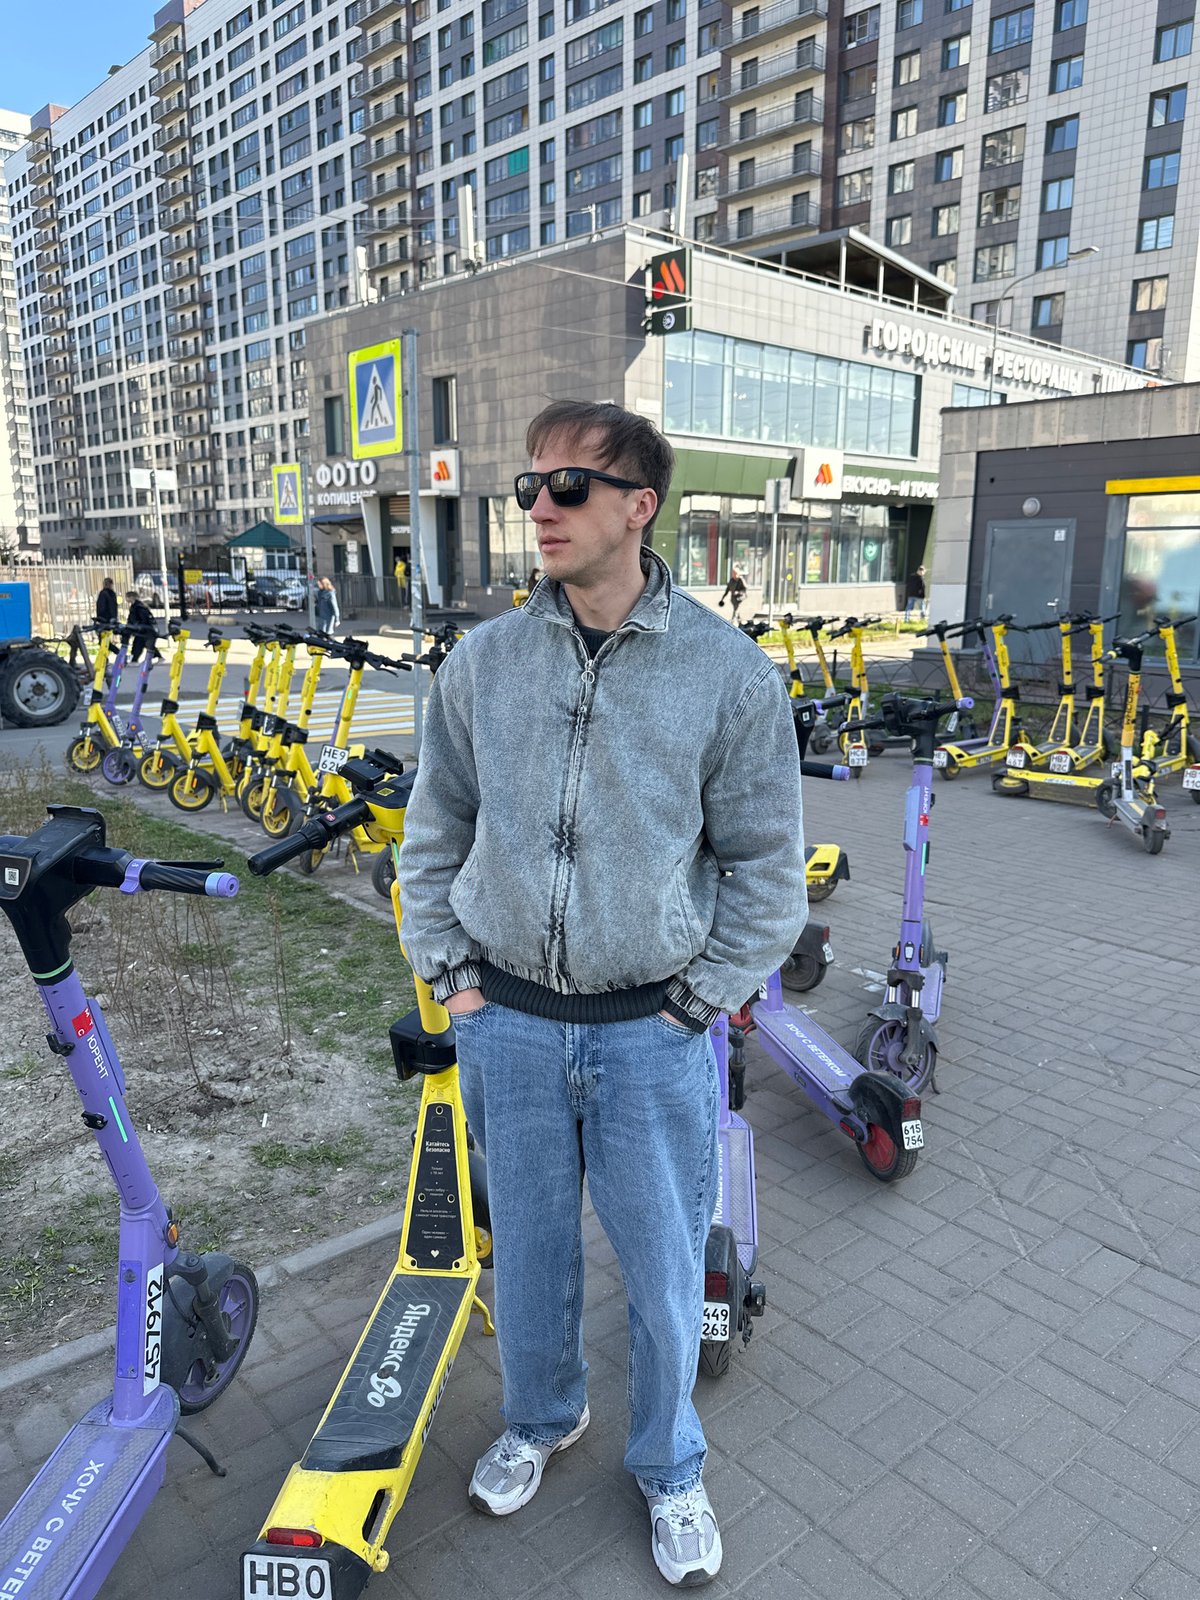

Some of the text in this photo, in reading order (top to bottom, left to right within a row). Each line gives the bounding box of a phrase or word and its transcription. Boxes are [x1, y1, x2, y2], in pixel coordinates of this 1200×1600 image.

[871, 318, 987, 372] ГОРОДСКИЕ
[993, 350, 1083, 393] РЕСТОРАНЫ
[316, 460, 376, 488] ФОТО
[842, 475, 891, 496] ВКУСНО
[87, 1034, 109, 1079] ЮРЕНТ
[785, 1023, 807, 1039] ХОЧУ
[807, 1044, 846, 1077] ВЕТЕРКОМ
[904, 1123, 921, 1135] 615
[905, 1135, 923, 1146] 754
[145, 1275, 163, 1380] 457912
[703, 1307, 729, 1321] 449
[702, 1322, 728, 1337] 263
[366, 1303, 431, 1408] Яндекс Go
[61, 1459, 105, 1514] ХОЧУ
[45, 1517, 65, 1533] С
